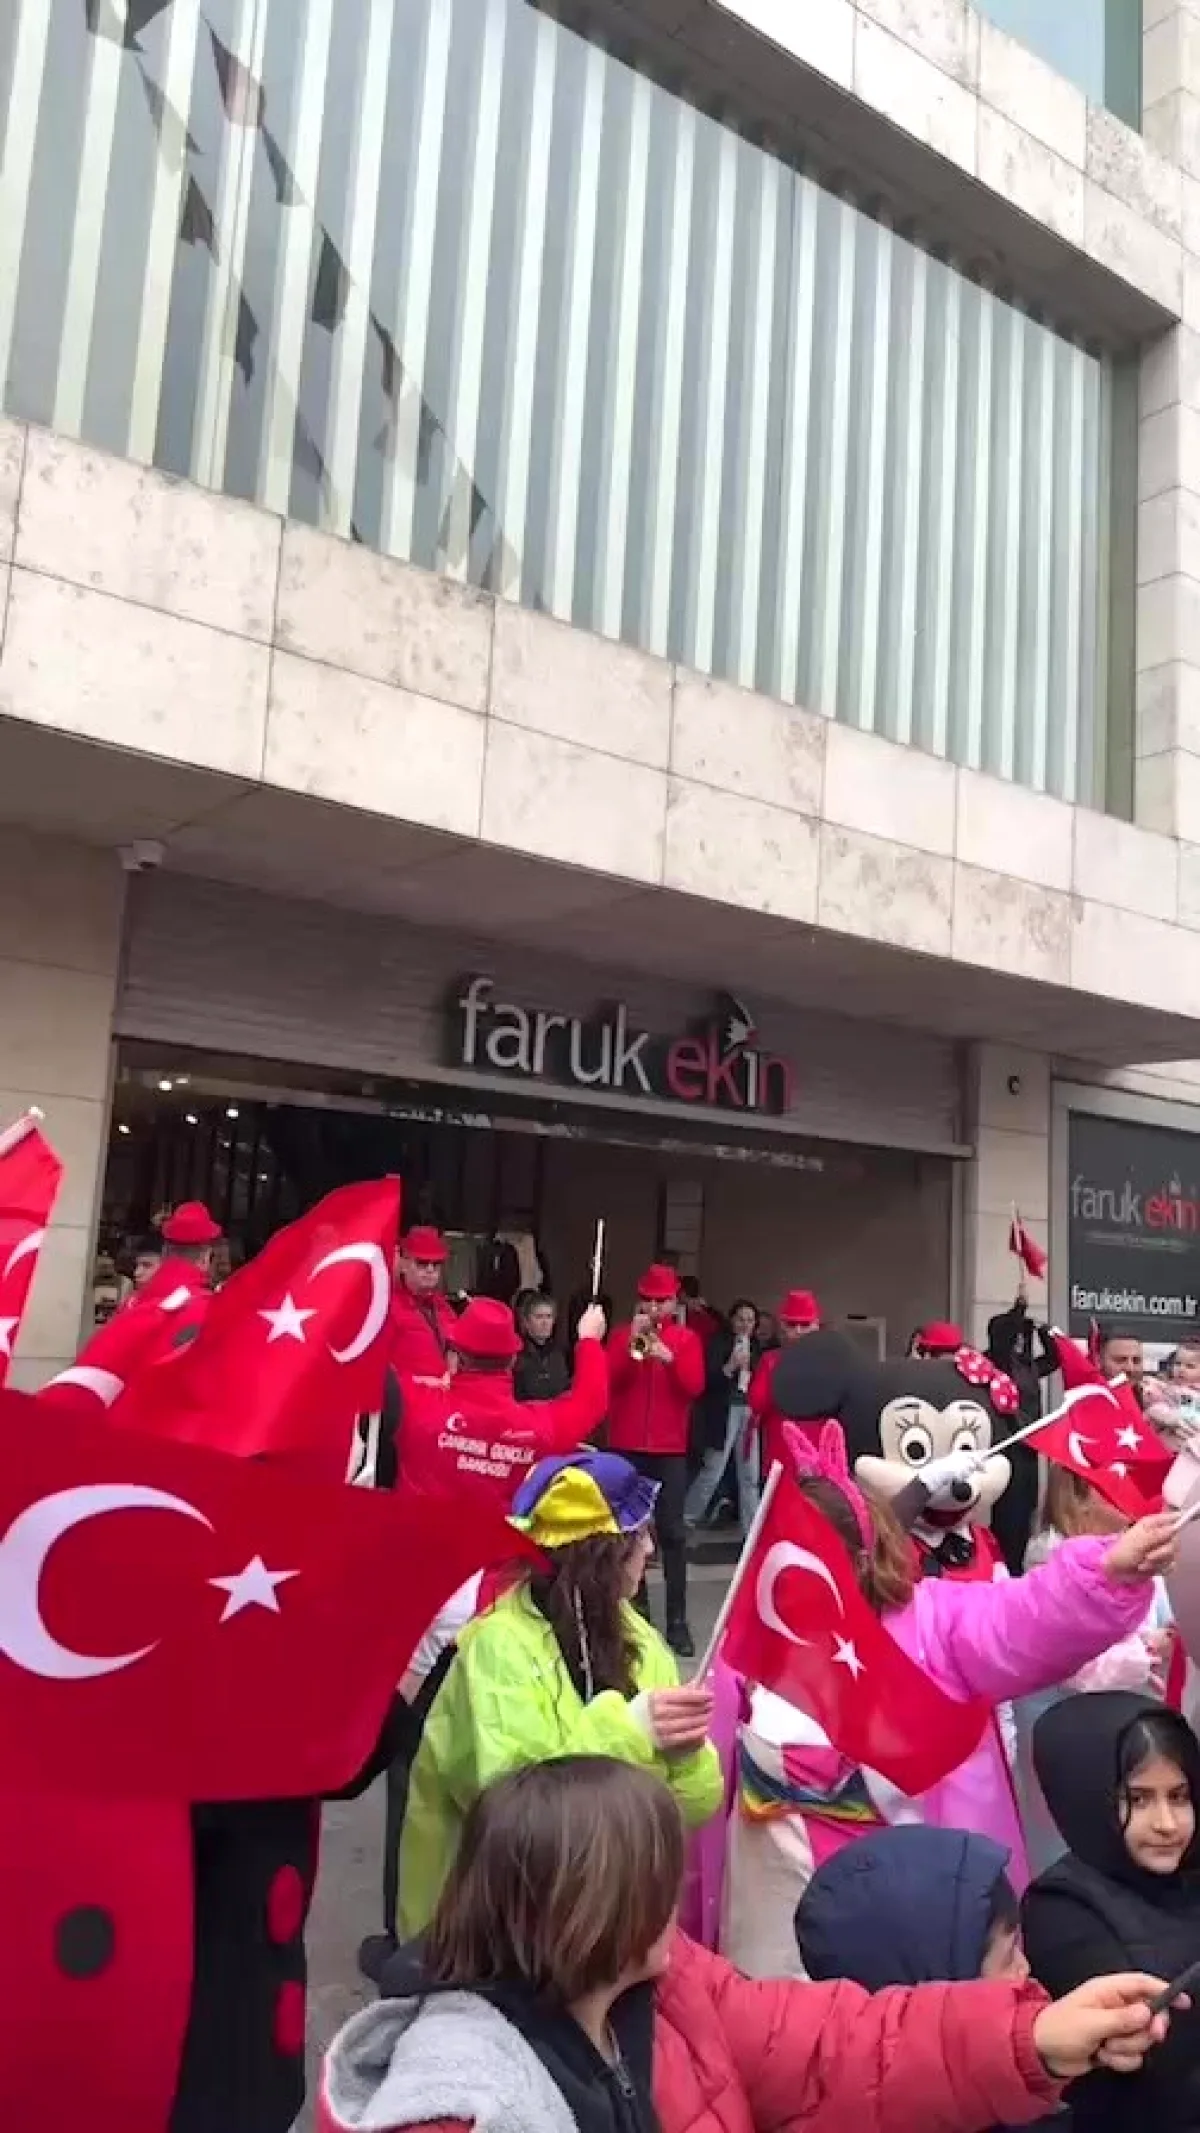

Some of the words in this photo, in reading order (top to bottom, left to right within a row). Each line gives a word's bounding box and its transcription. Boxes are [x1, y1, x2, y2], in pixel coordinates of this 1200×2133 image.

[459, 977, 651, 1093] faruk
[666, 1022, 795, 1115] ekin
[1071, 1173, 1143, 1227] faruk
[1145, 1181, 1199, 1233] ekin
[1071, 1285, 1197, 1316] farukekin.com.tr
